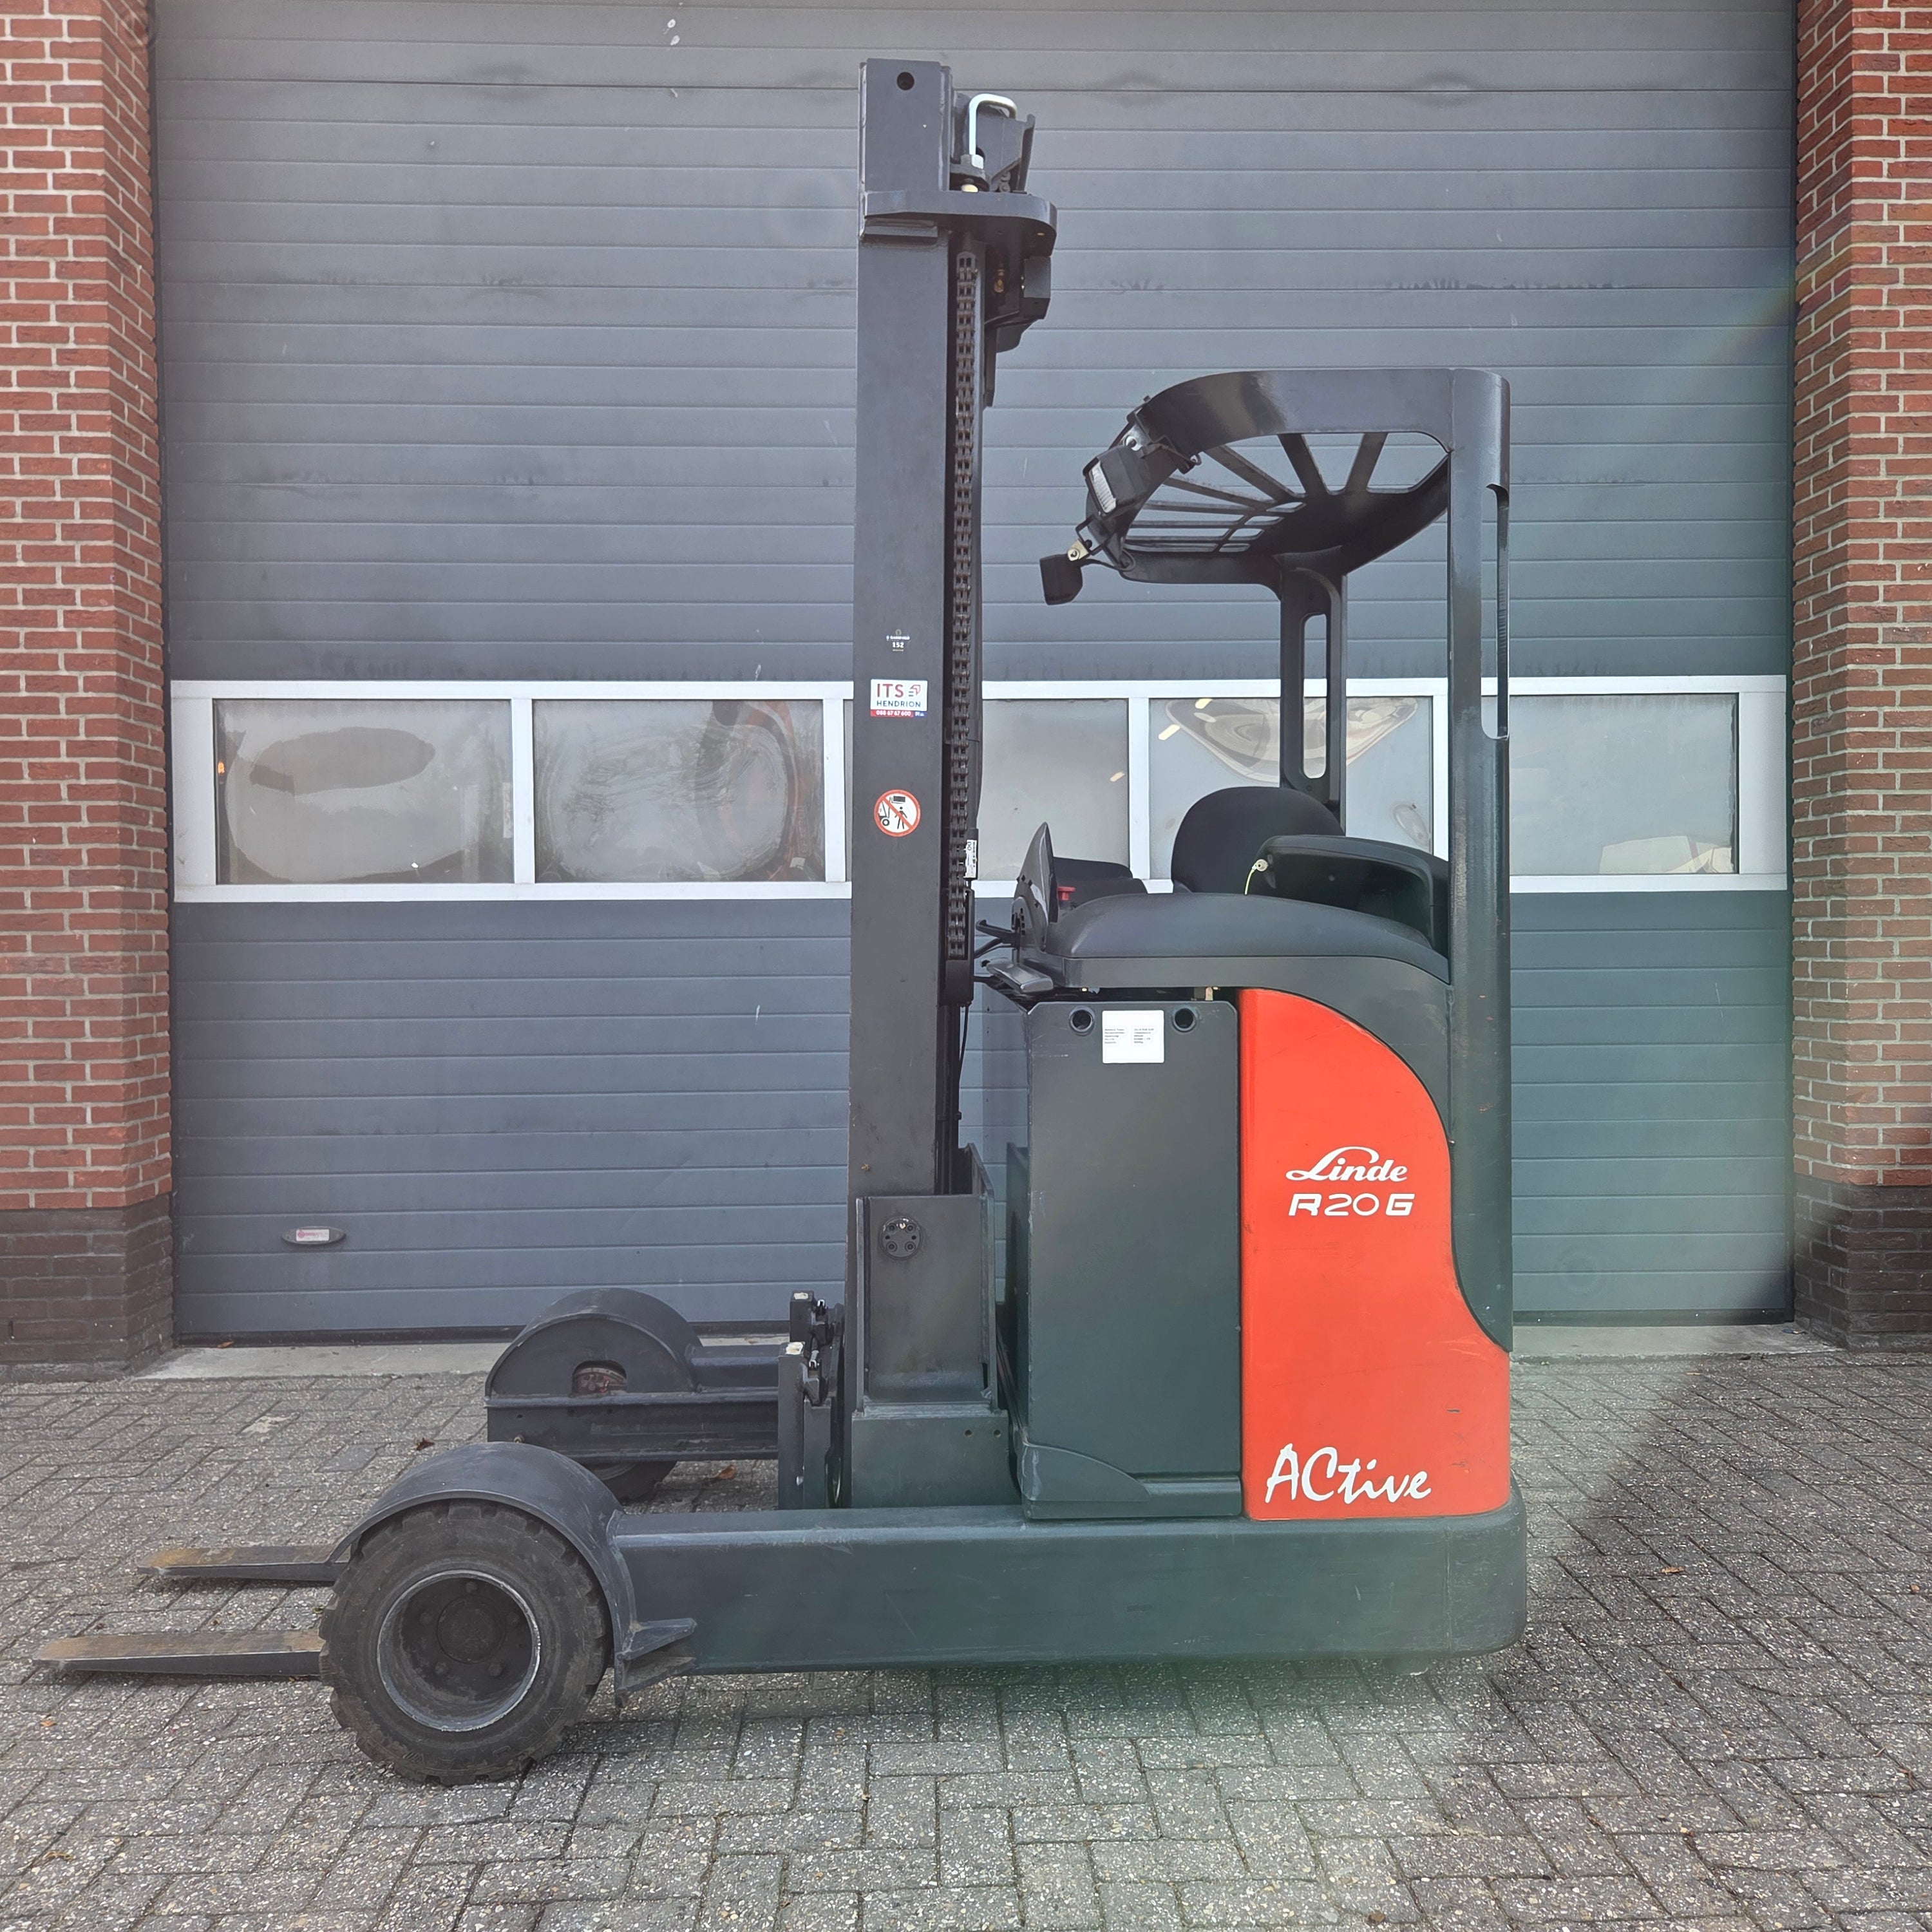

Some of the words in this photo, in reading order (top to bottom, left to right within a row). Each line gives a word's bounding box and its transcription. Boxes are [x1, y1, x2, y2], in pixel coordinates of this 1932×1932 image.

[877, 683, 904, 698] ITS
[1285, 1146, 1407, 1182] Linde
[1265, 1443, 1432, 1504] ACtive
